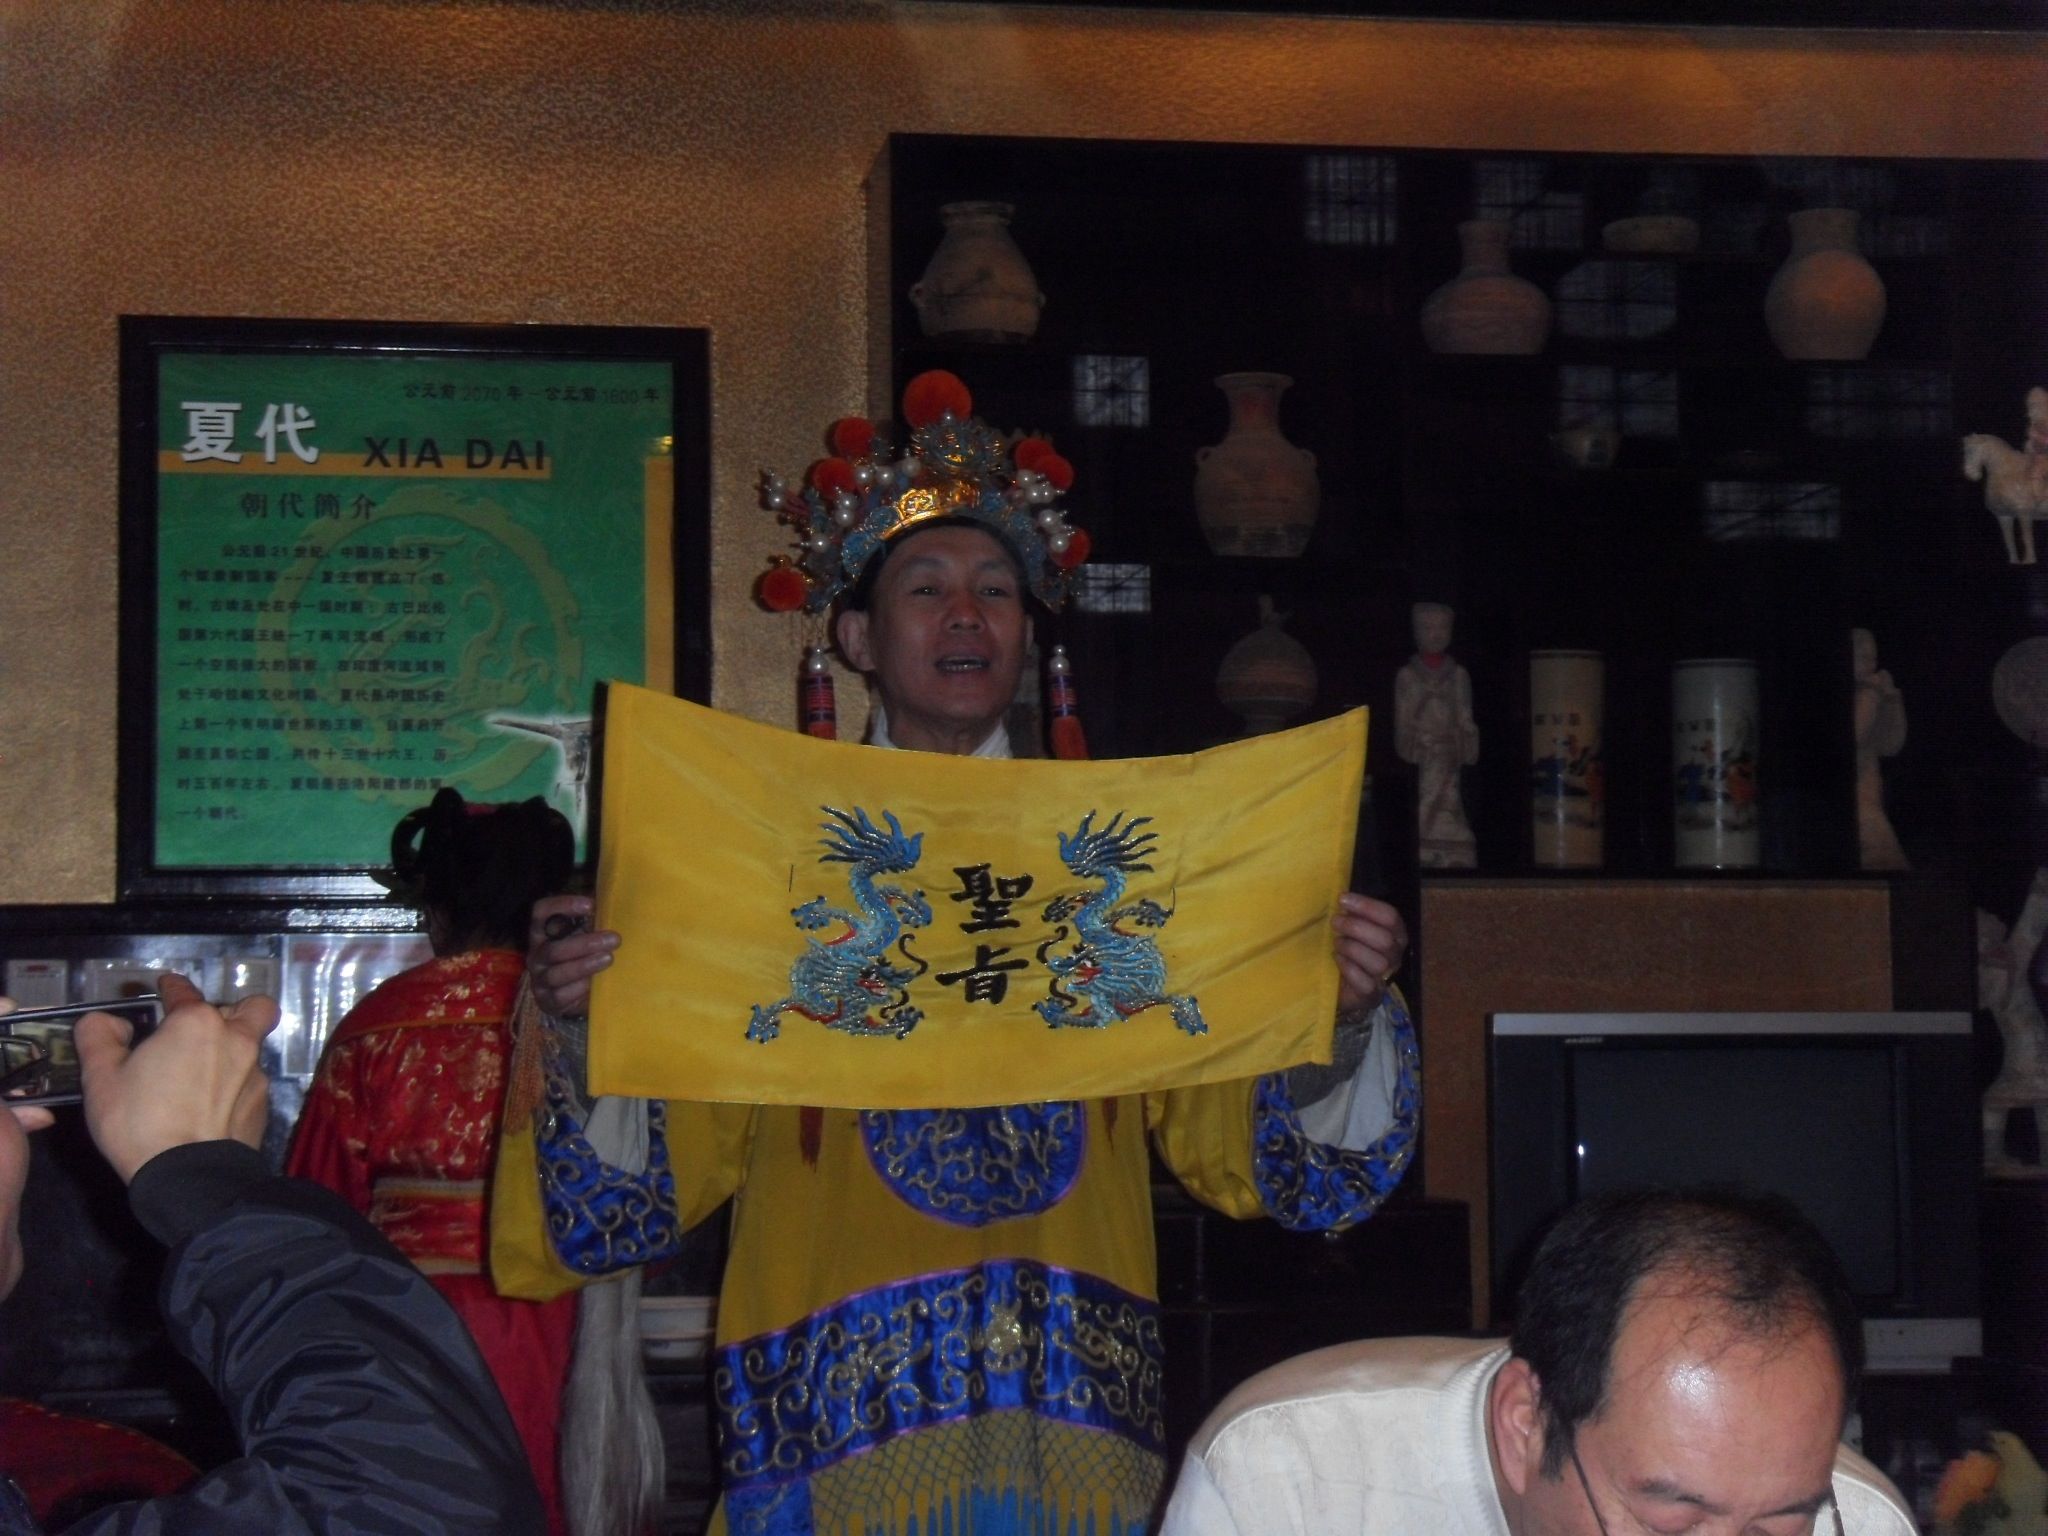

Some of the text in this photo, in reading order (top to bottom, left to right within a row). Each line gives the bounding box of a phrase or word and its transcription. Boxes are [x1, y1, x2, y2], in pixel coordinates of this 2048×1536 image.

[180, 401, 319, 464] 夏代
[363, 436, 545, 471] XIA DAI
